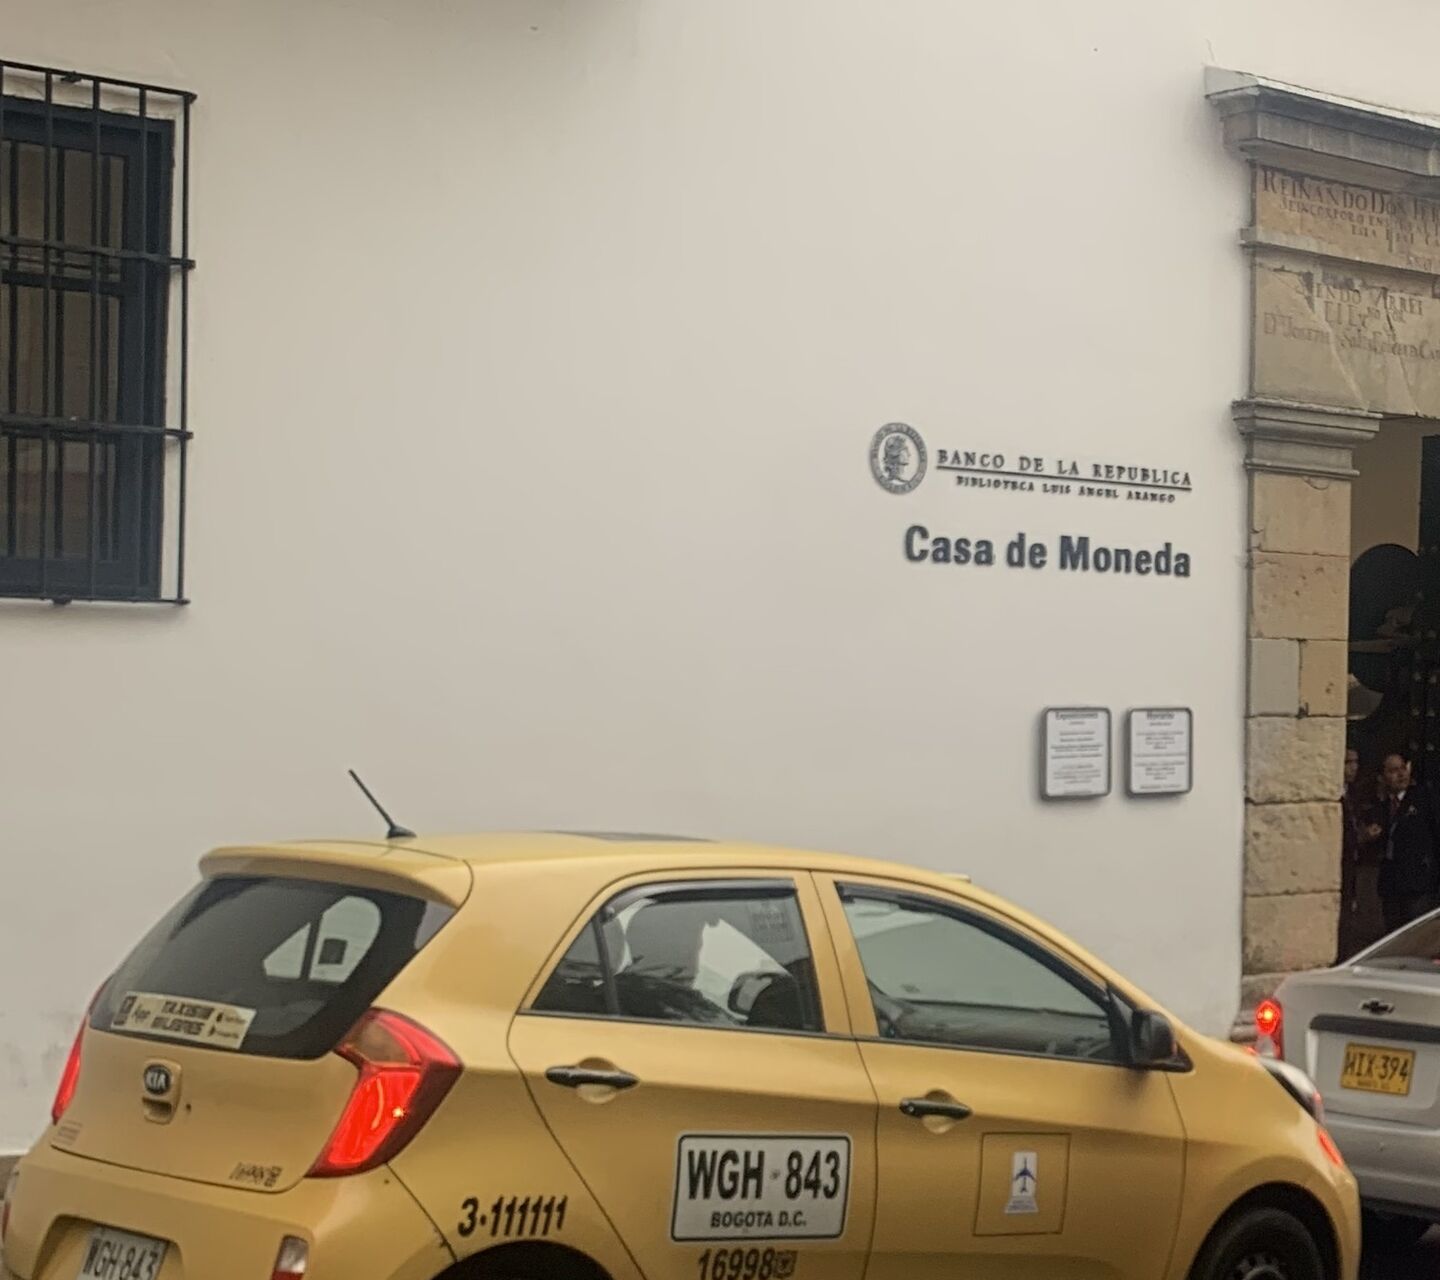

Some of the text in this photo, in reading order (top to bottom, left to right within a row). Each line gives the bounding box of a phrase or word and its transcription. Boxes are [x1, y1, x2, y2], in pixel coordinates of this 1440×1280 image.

[936, 449, 1192, 487] BANCO DE LA REPUBLICA
[956, 476, 1035, 492] BIBLIOTECA
[1042, 483, 1071, 495] LUIS
[1126, 490, 1176, 504] ARANGO
[905, 525, 1192, 578] Casa de Moneda
[145, 1072, 167, 1089] KIA
[1378, 1054, 1410, 1083] 394
[687, 1149, 841, 1200] WGH 843
[710, 1209, 807, 1228] BOGOTA D.C.
